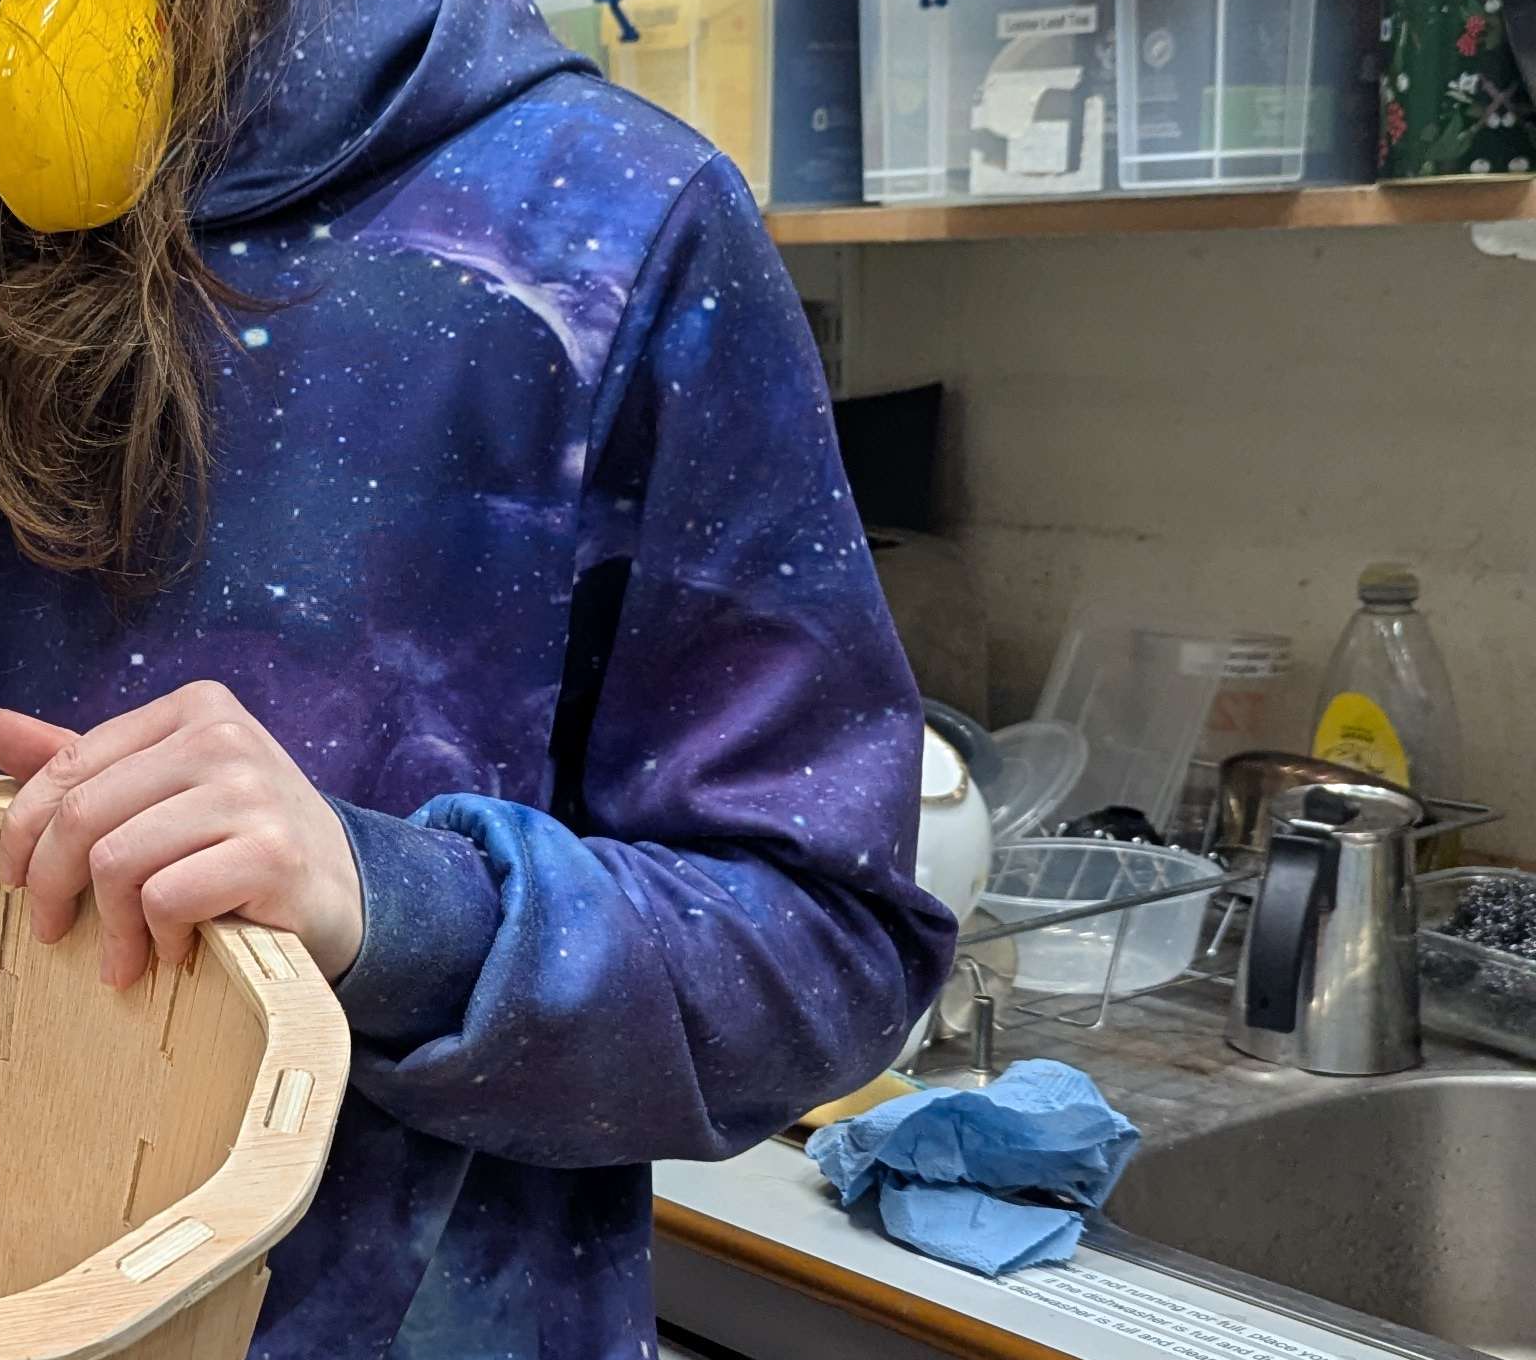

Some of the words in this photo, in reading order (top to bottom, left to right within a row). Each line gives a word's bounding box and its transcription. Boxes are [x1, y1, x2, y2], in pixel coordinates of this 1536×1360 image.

[1008, 1284, 1096, 1320] dishwasher
[1095, 1316, 1111, 1326] is
[1111, 1321, 1141, 1336] full
[1137, 1330, 1174, 1347] and
[1055, 1281, 1082, 1294] the
[1083, 1291, 1173, 1326] dishwasher
[1172, 1322, 1188, 1332] is
[1189, 1327, 1216, 1344] full
[1215, 1338, 1251, 1356] and
[1083, 1270, 1099, 1279] is
[1099, 1275, 1127, 1290] not
[1126, 1285, 1185, 1312] running
[1187, 1307, 1217, 1325] nor
[1248, 1332, 1299, 1353] place
